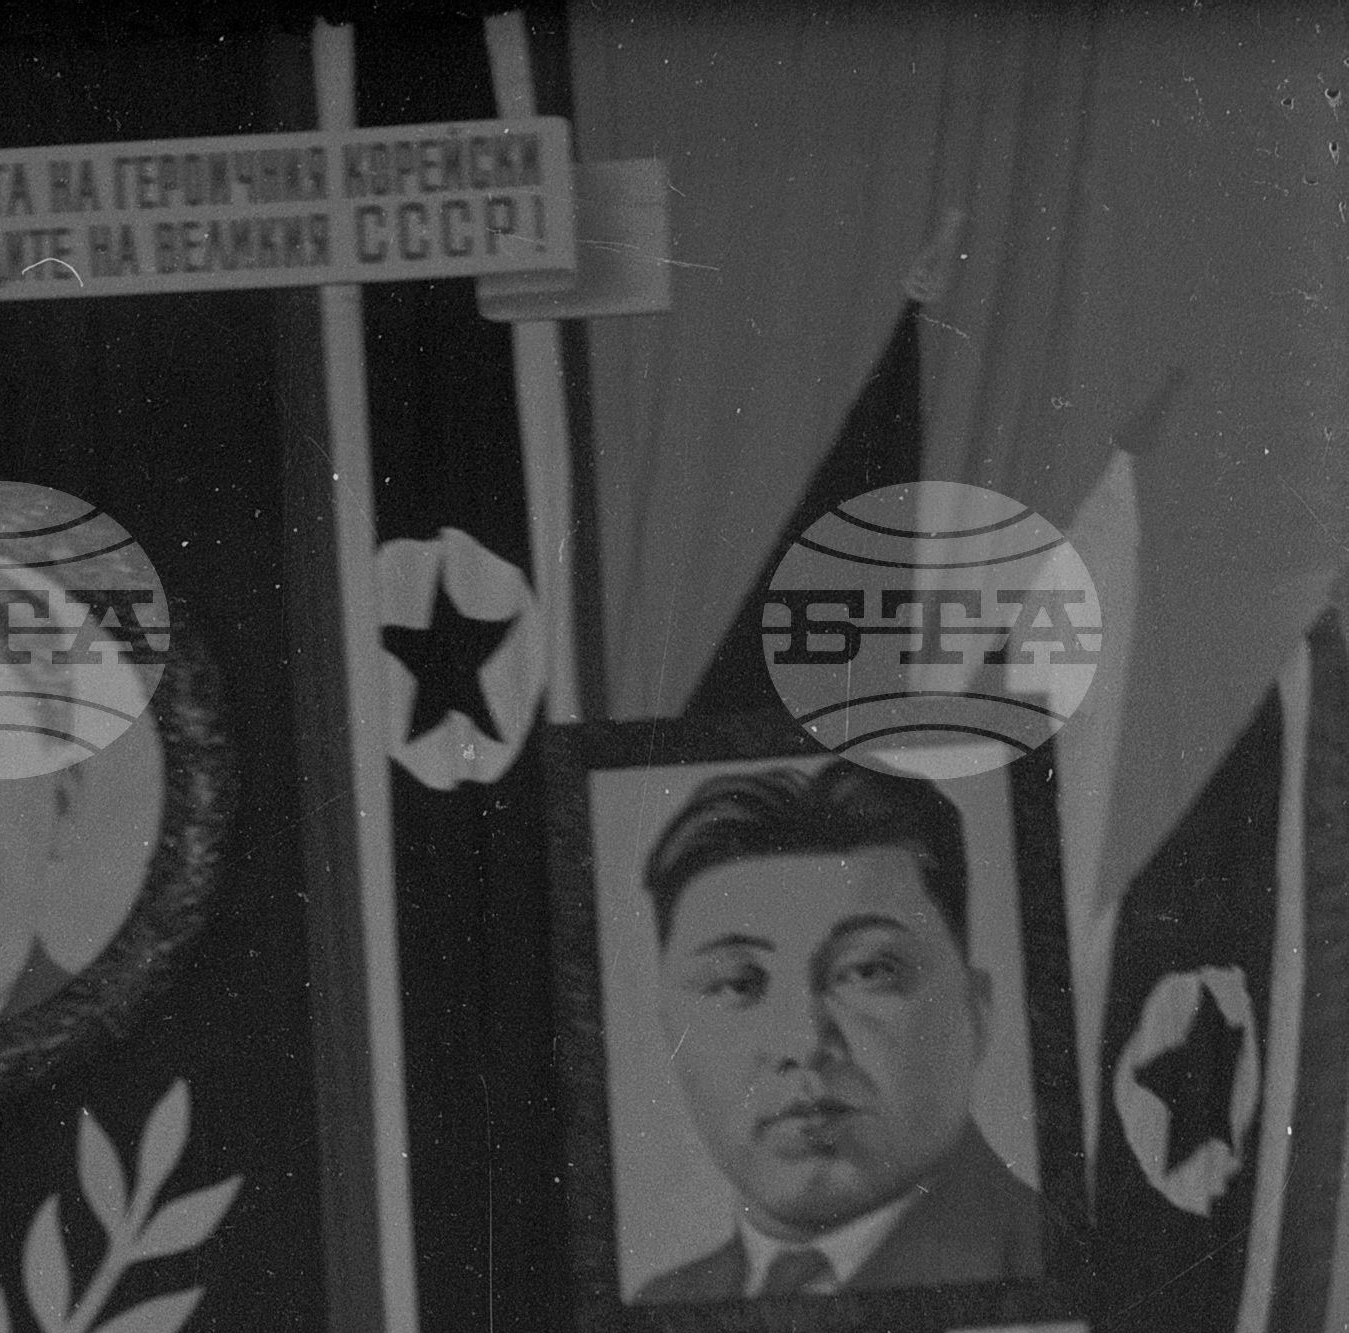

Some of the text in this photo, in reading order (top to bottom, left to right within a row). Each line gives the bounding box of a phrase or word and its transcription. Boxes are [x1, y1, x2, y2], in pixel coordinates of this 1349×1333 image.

[50, 159, 102, 214] НА
[115, 146, 327, 211] ГЕРОИЧНИЯ
[89, 223, 140, 278] НА
[155, 212, 329, 274] ВЕЛИКИЯ
[357, 193, 546, 263] СССР!
